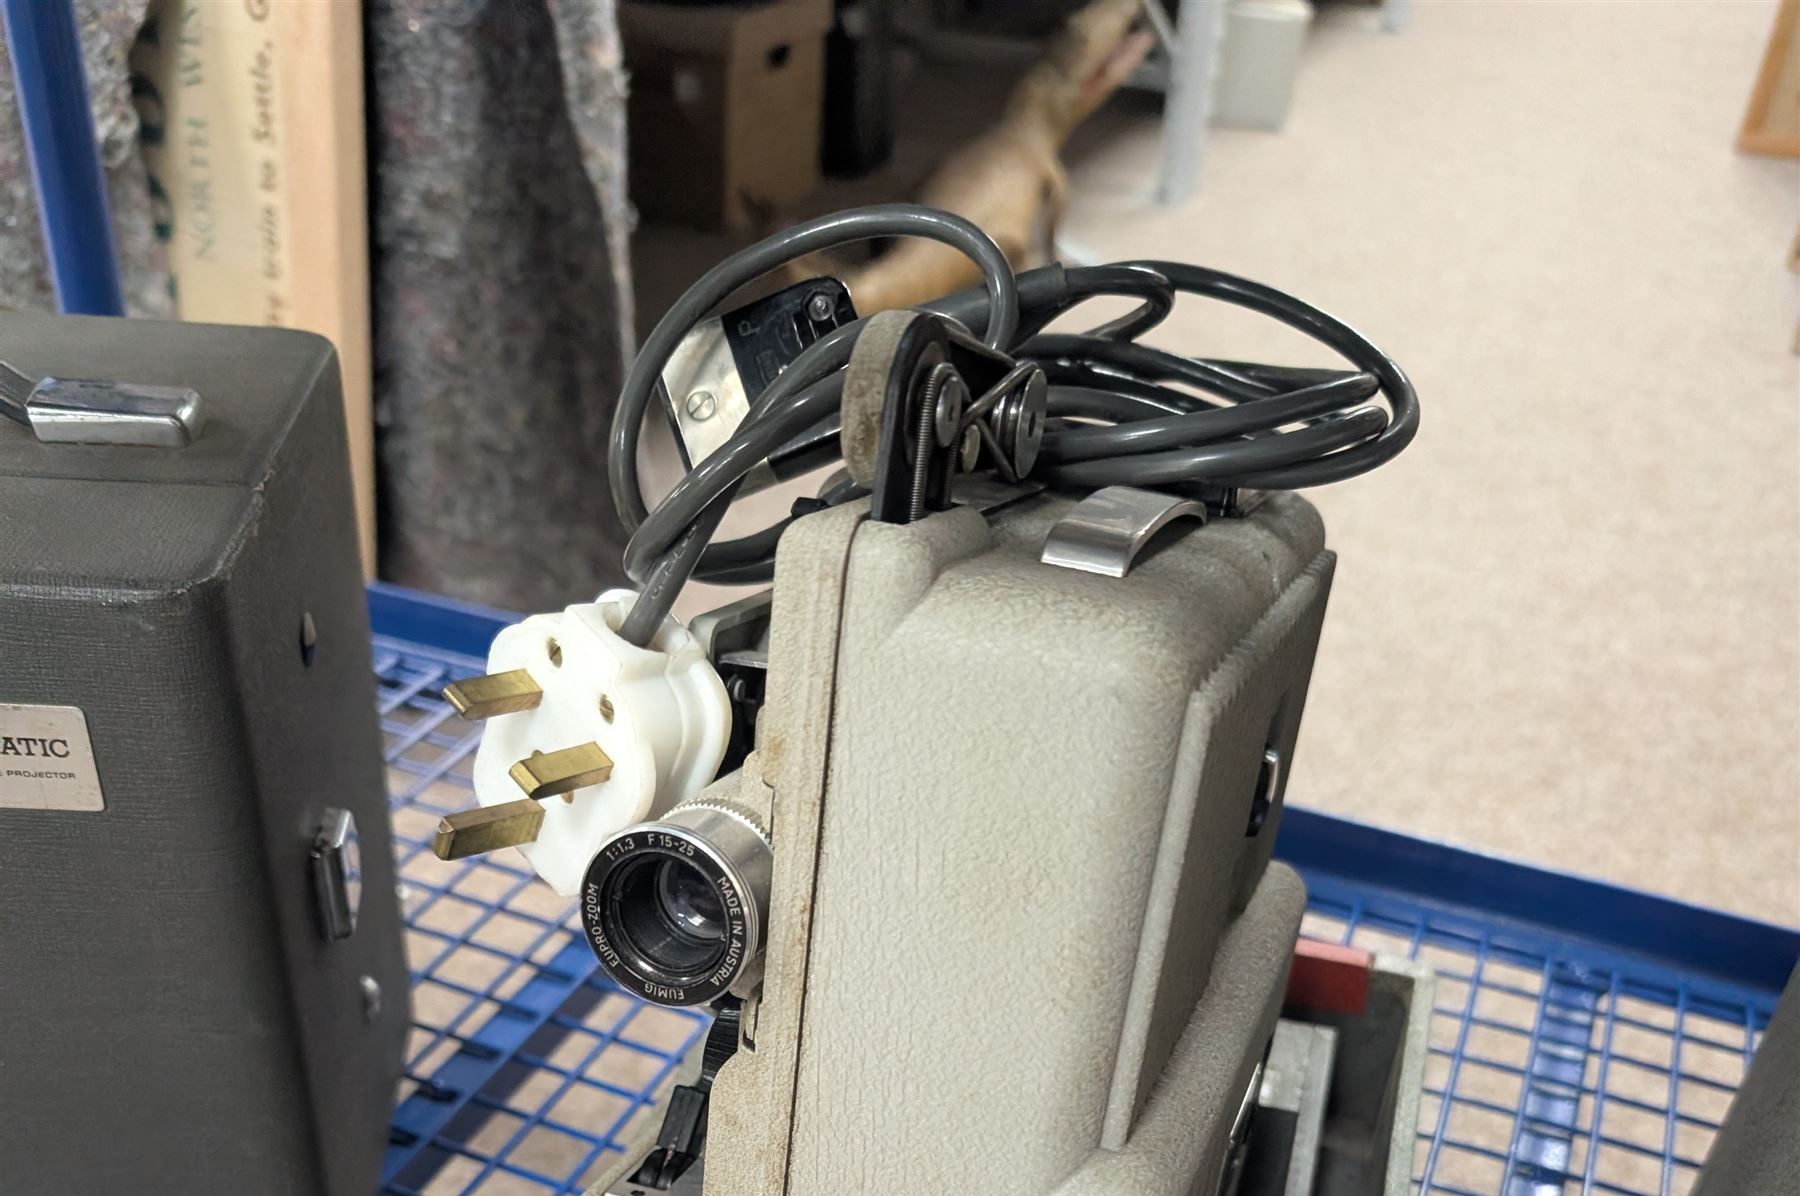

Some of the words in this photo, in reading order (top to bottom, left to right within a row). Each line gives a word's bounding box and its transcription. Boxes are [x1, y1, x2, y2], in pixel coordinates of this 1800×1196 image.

[0, 736, 70, 758] ATIC
[6, 770, 76, 779] PROJECTOR
[717, 876, 741, 916] MADE
[732, 919, 744, 936] IN
[710, 938, 744, 987] AUSTRIA
[644, 983, 685, 1000] EUMIG
